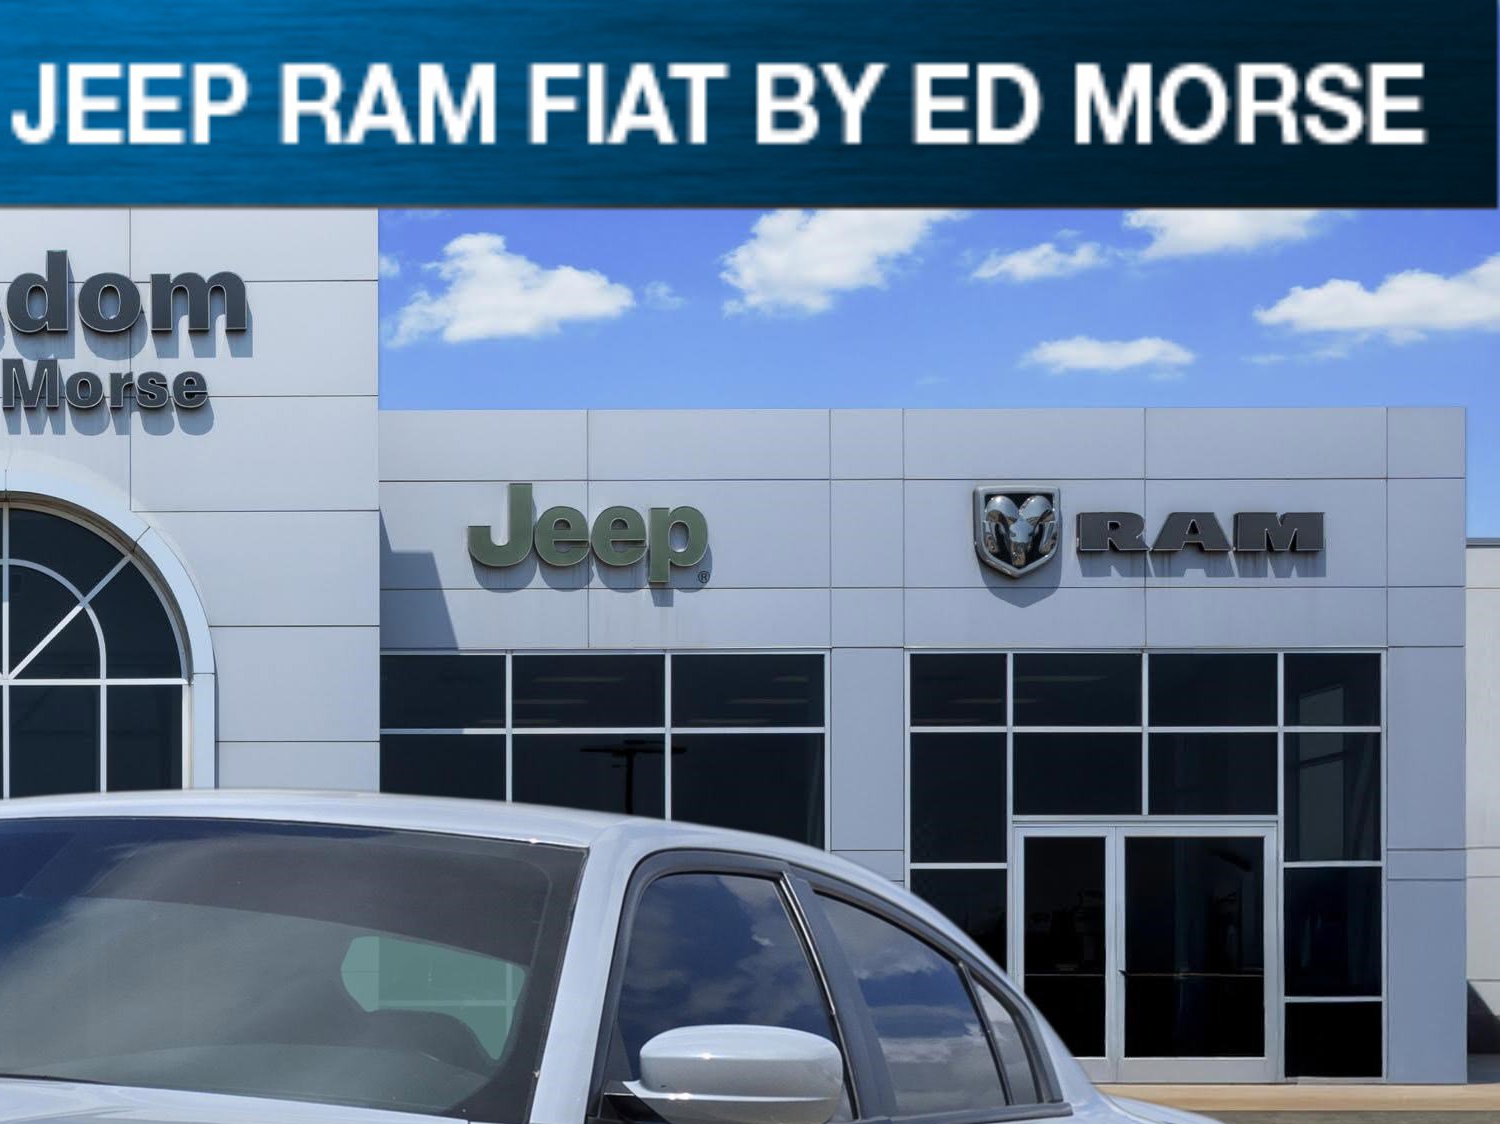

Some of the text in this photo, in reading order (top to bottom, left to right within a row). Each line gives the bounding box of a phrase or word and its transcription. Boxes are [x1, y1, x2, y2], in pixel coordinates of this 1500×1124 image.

[2, 358, 208, 410] Morse
[467, 482, 709, 583] Jeep
[1076, 511, 1325, 553] RAM
